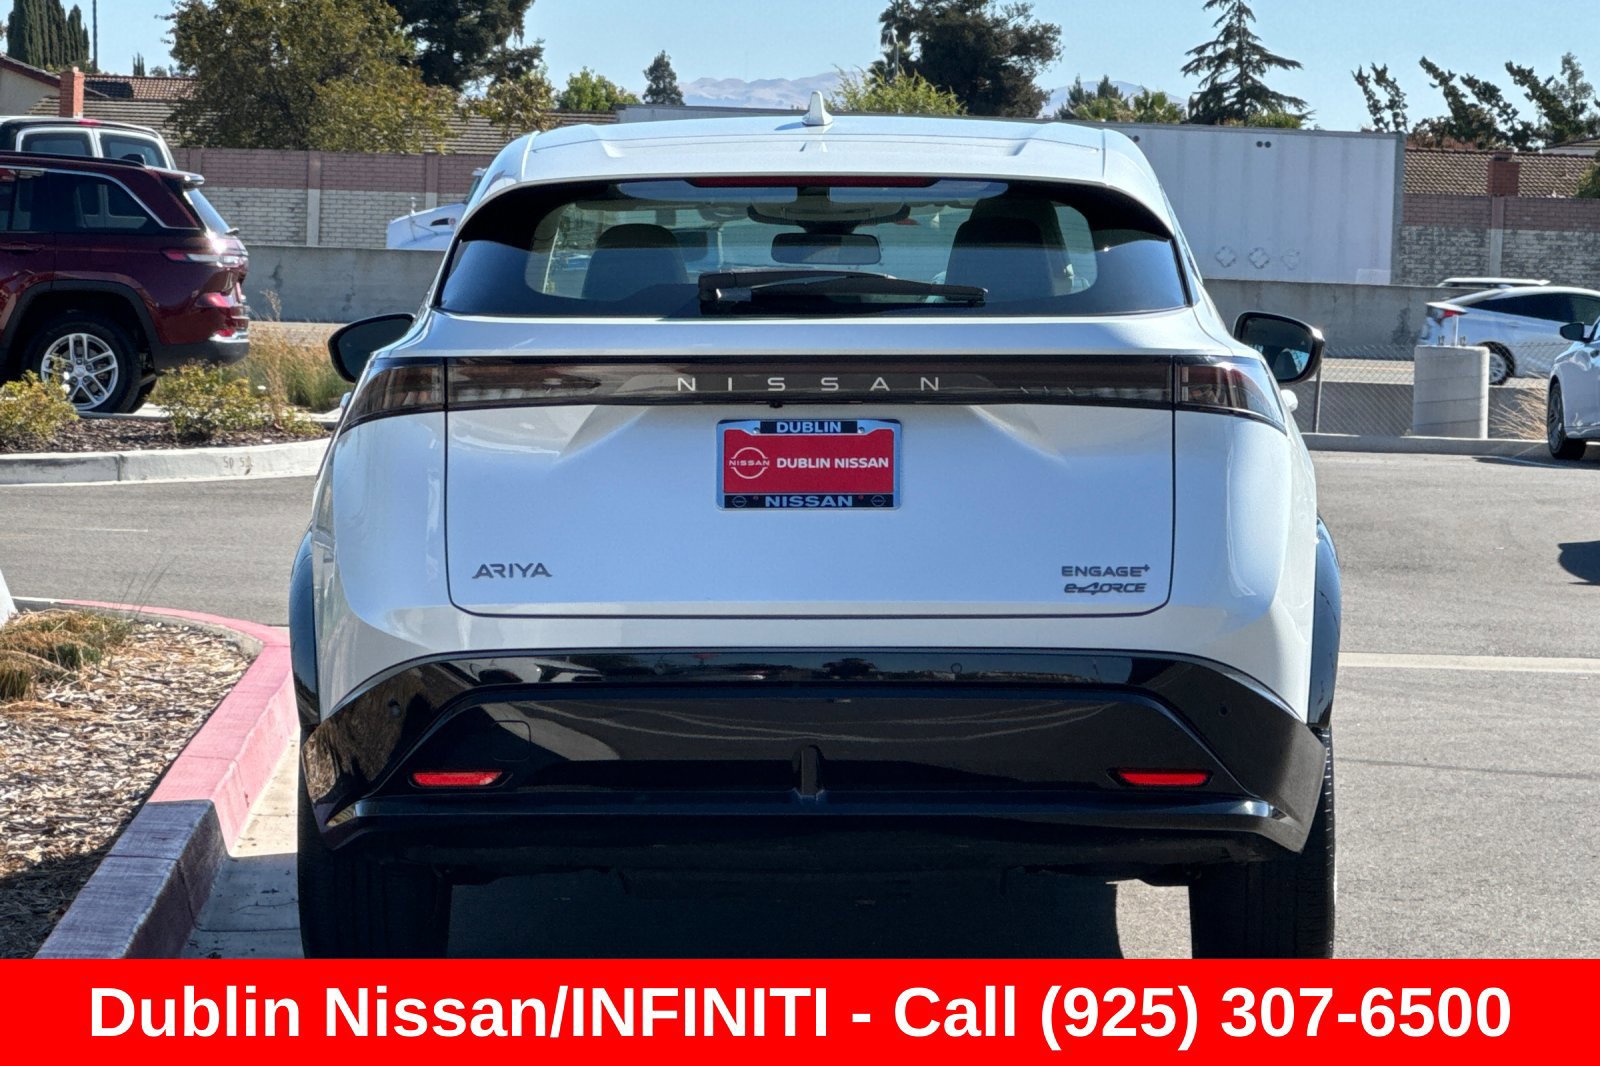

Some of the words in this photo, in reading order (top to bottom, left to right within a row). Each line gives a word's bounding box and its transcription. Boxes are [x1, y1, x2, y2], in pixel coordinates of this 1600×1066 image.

[677, 377, 939, 391] NISSAN
[776, 421, 842, 434] DUBLIN
[776, 457, 830, 469] DUBLIN
[834, 457, 889, 469] NISSAN
[765, 495, 853, 508] NISSAN
[472, 562, 553, 579] ARIYA
